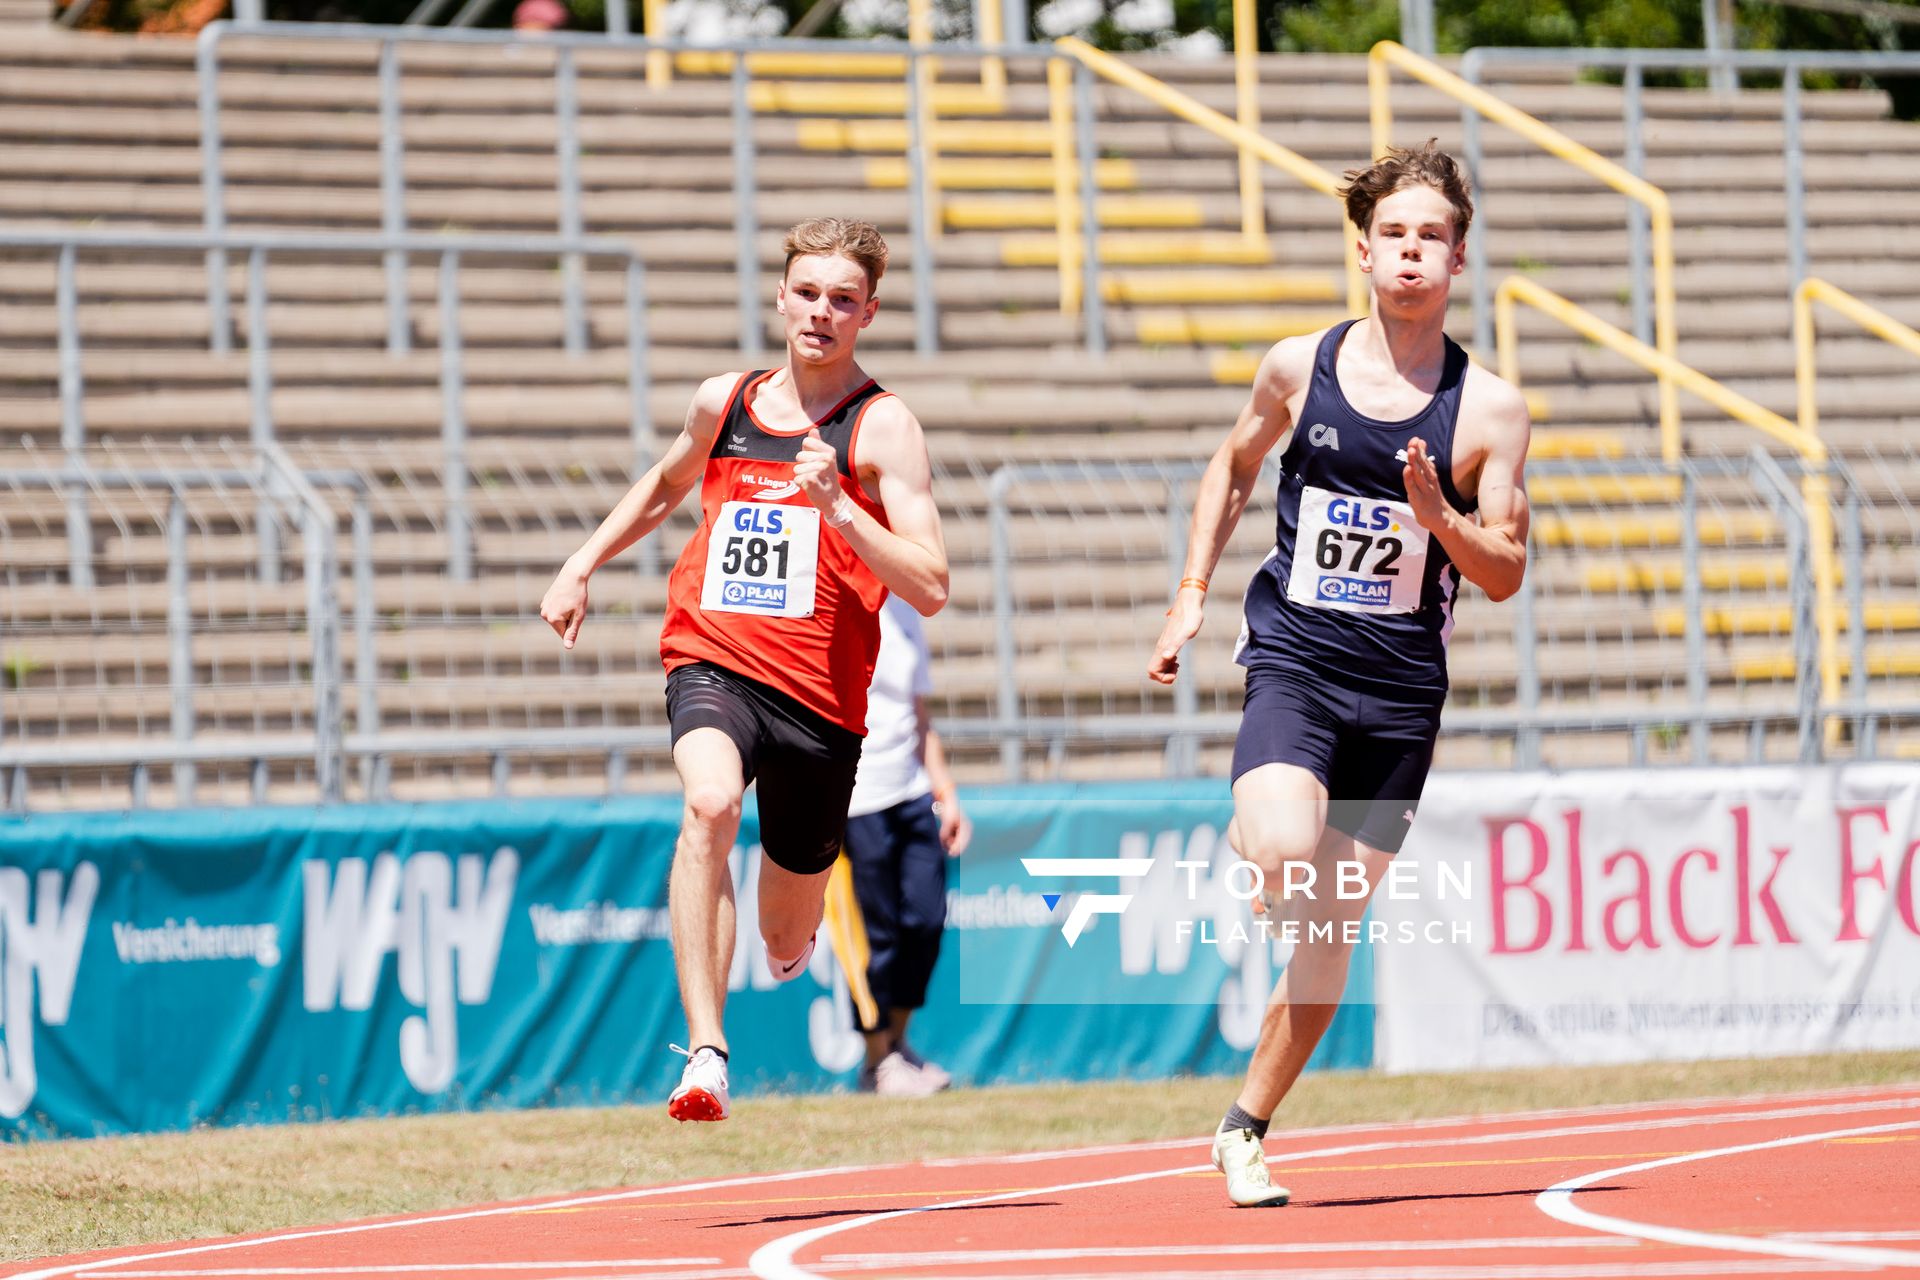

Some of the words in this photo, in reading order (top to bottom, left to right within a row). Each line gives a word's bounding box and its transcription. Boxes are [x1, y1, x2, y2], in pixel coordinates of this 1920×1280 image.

[722, 536, 790, 580] 581
[1315, 528, 1403, 576] 672
[747, 586, 784, 601] PLAN
[1347, 582, 1388, 597] PLAN
[1482, 805, 1800, 953] Black
[113, 917, 281, 967] Versicherung
[529, 899, 672, 945] Versicherun
